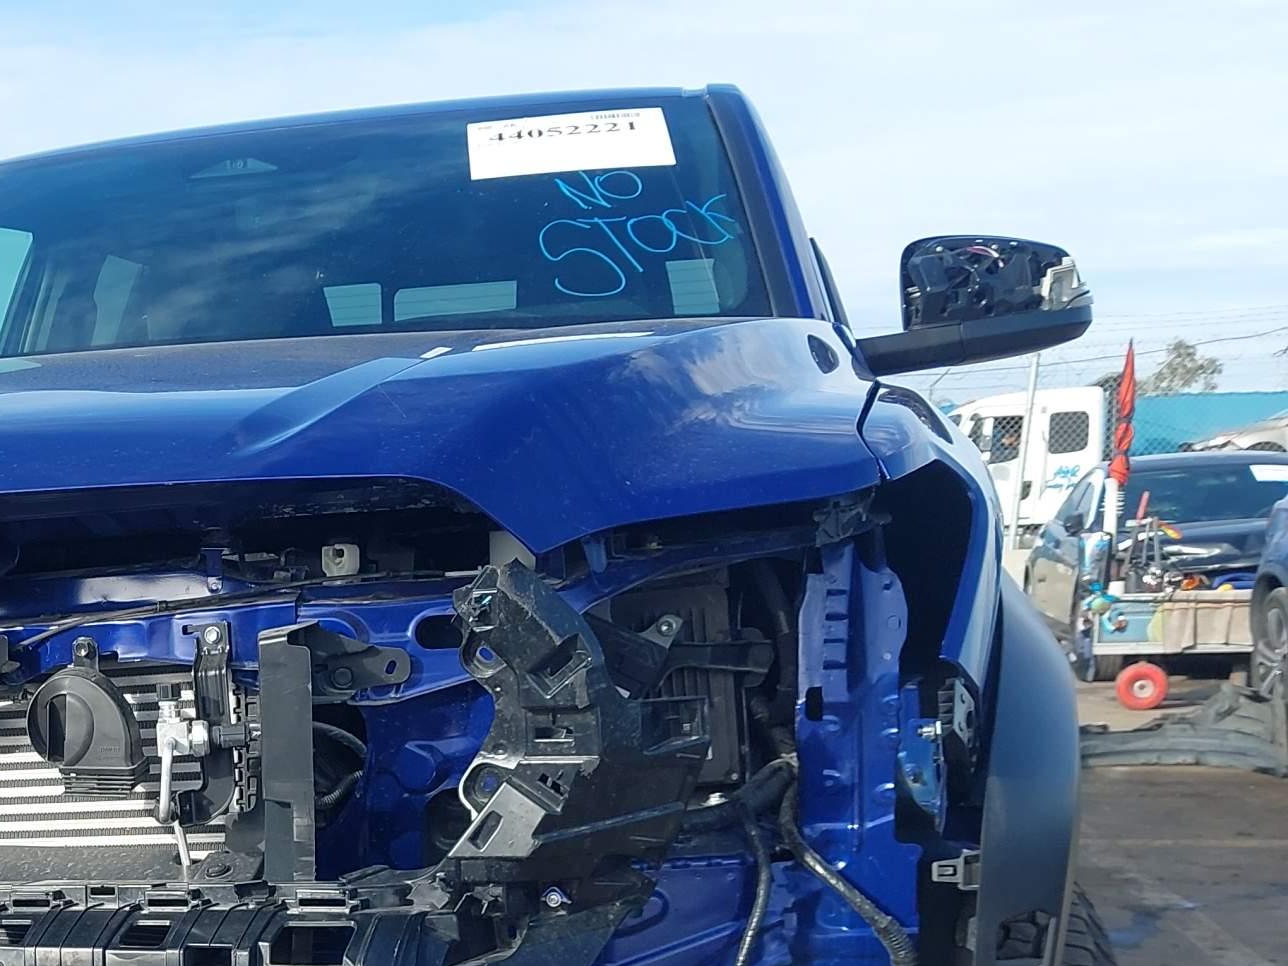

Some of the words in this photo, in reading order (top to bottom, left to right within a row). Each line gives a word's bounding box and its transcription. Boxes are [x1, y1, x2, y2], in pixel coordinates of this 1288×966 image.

[489, 121, 636, 142] 44052221
[554, 170, 643, 210] NO
[539, 193, 736, 297] STOCK
